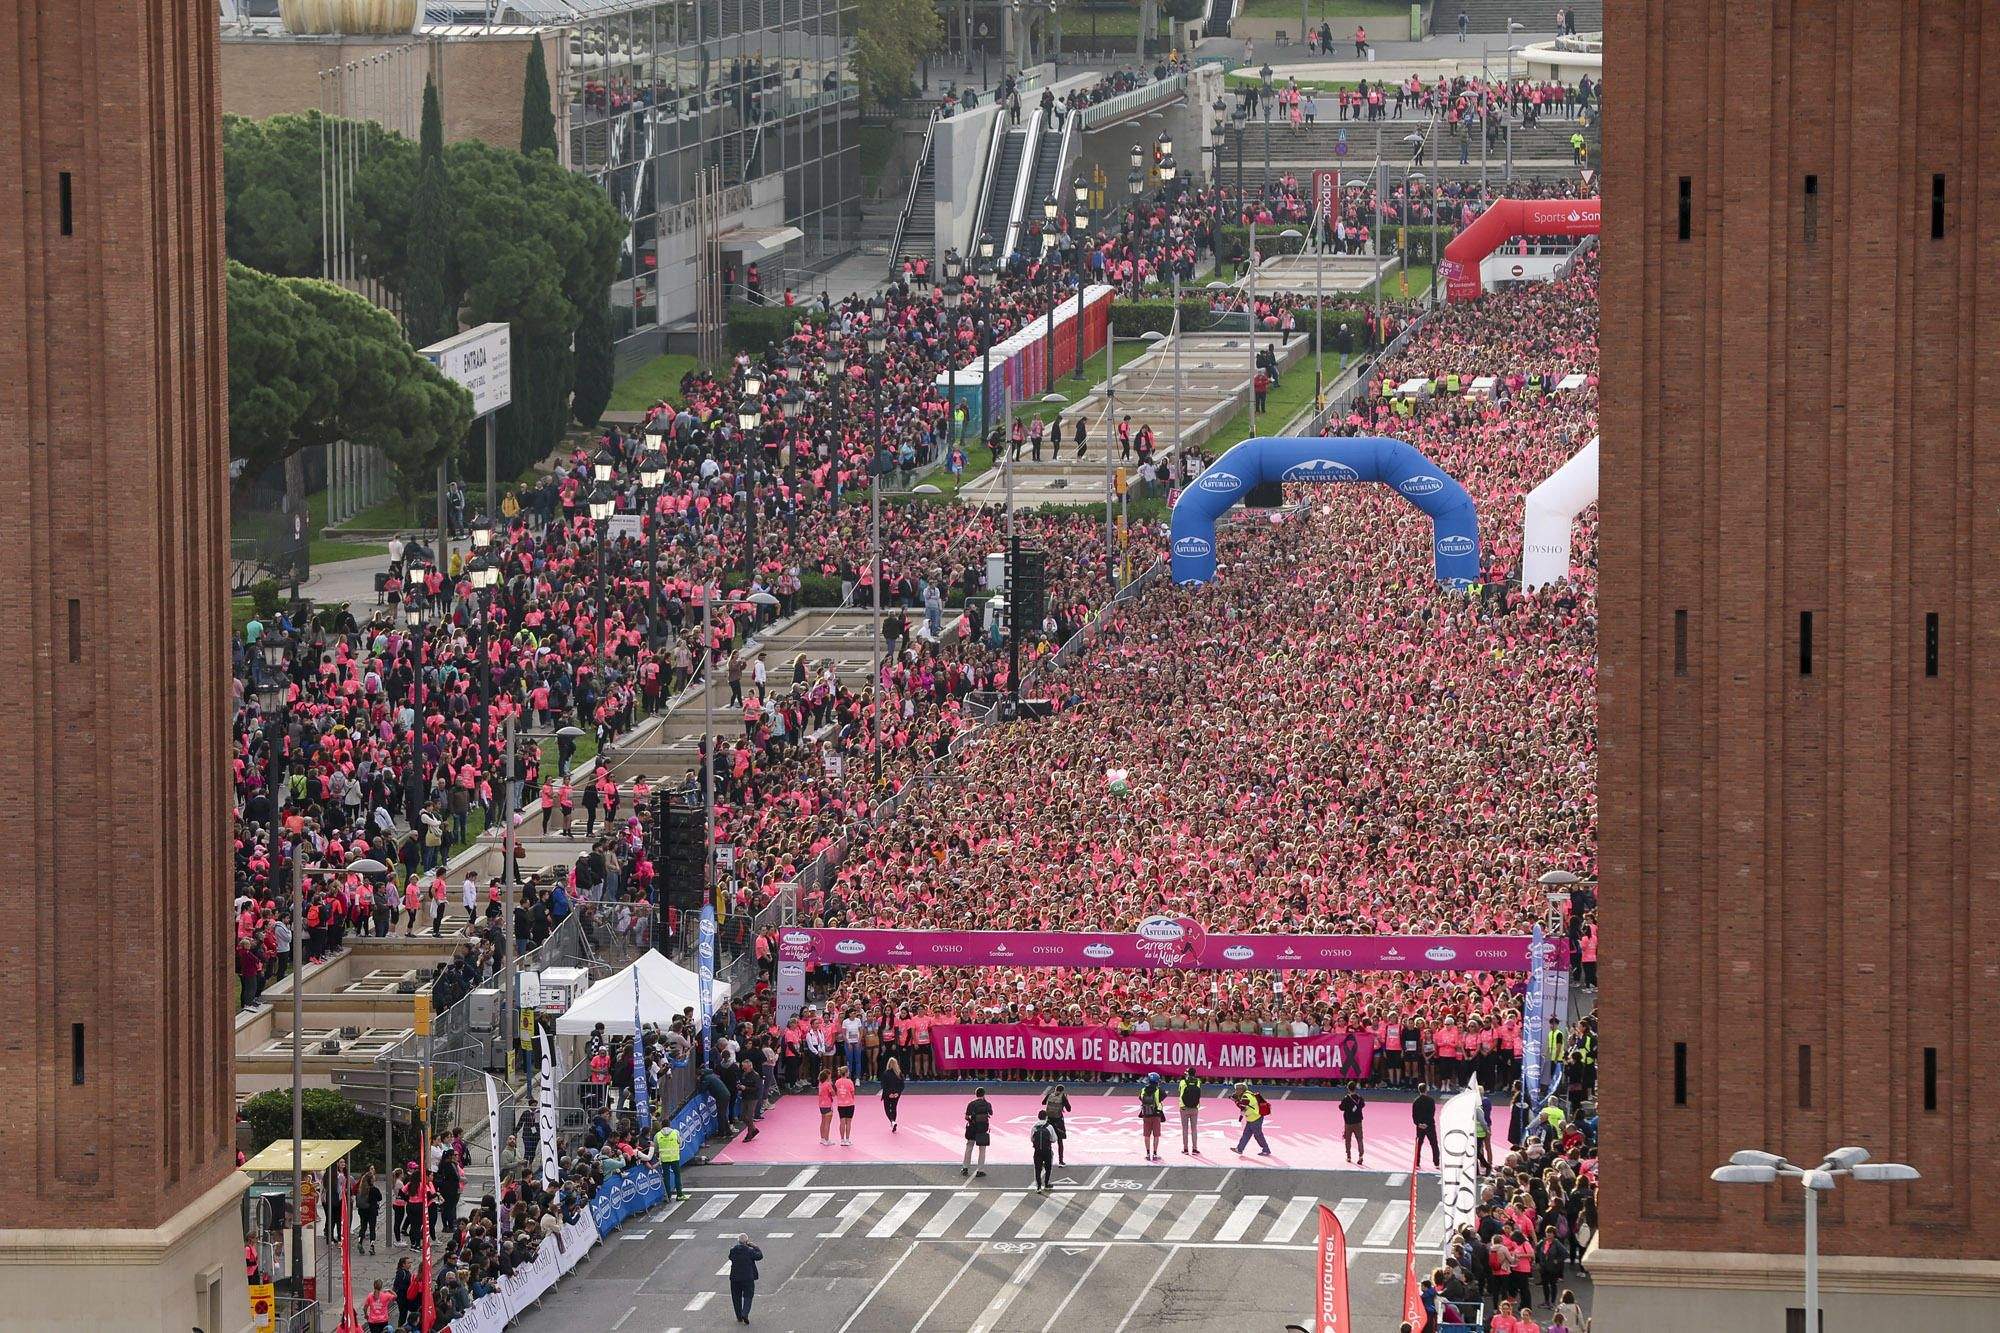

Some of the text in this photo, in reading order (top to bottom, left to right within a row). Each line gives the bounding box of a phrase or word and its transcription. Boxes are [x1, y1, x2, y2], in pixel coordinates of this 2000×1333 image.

[1534, 212, 1566, 224] Sports
[463, 346, 487, 374] ENTRADA
[1288, 472, 1353, 481] ASTURIANA
[1202, 480, 1239, 488] ASTURIANA
[1403, 483, 1440, 491] ASTURIANA
[1176, 544, 1208, 553] ASTURIANA
[1440, 543, 1472, 552] ASTURIANA
[1528, 545, 1563, 554] OYSHO
[1143, 927, 1183, 936] ASTURIANA
[1135, 939, 1173, 951] Carrera
[887, 949, 912, 957] Santander
[932, 944, 963, 953] OYSHO
[1032, 945, 1064, 954] OYSHO
[1320, 948, 1352, 957] OYSHO
[1475, 949, 1507, 958] OYSHO
[1157, 953, 1186, 967] Mujer
[943, 1036, 1343, 1069] LA MAREA ROSA DE BARCELONA, AMB VALÈNCIA
[505, 1267, 528, 1297] OYSHO
